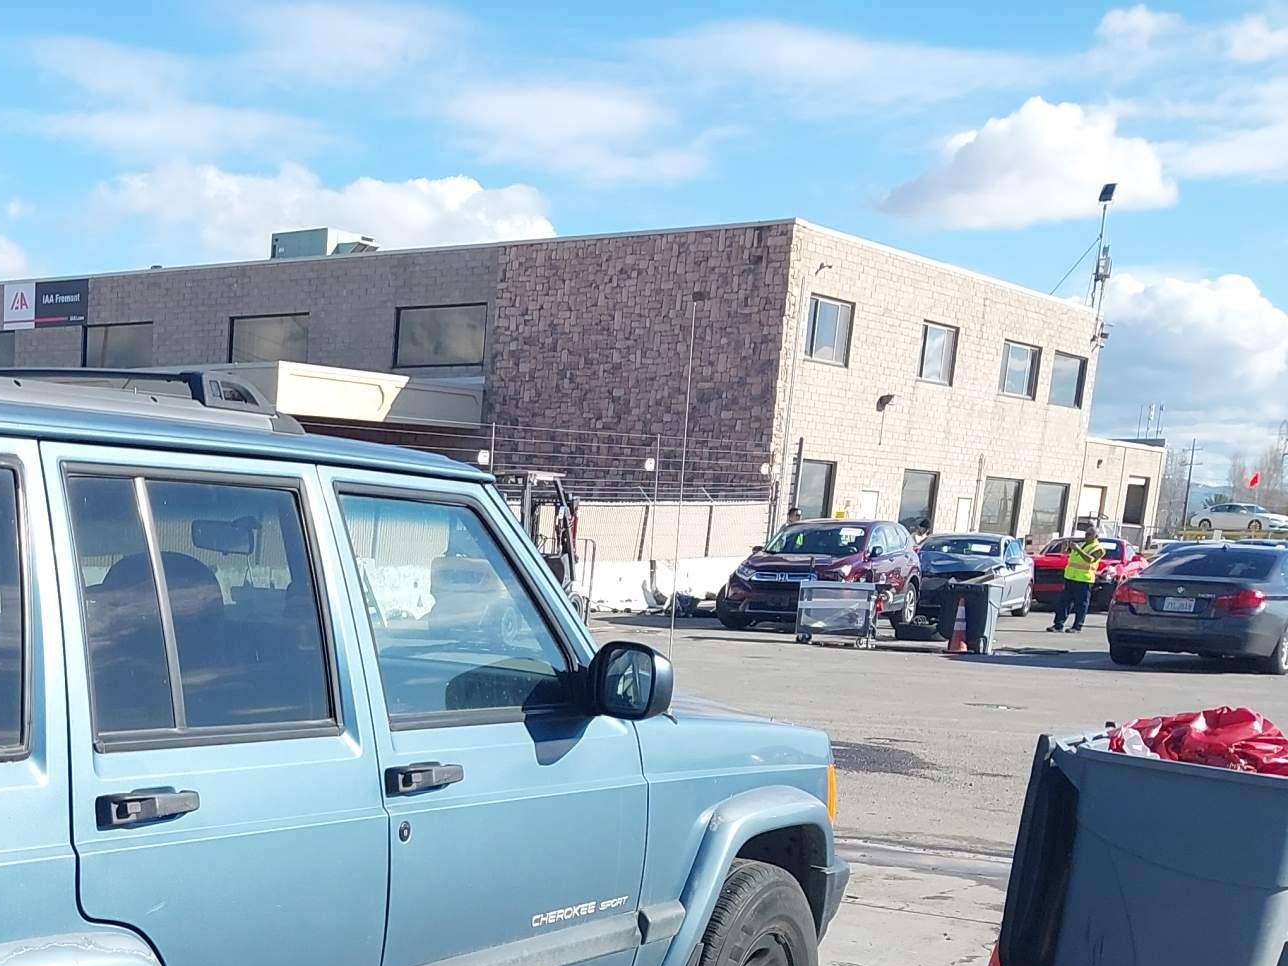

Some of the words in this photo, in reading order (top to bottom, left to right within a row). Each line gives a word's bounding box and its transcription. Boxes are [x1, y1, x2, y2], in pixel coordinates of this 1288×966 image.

[42, 294, 54, 304] IAA
[55, 293, 80, 303] Fremont
[531, 901, 596, 927] CHEROKEE
[599, 895, 628, 910] SPORT
